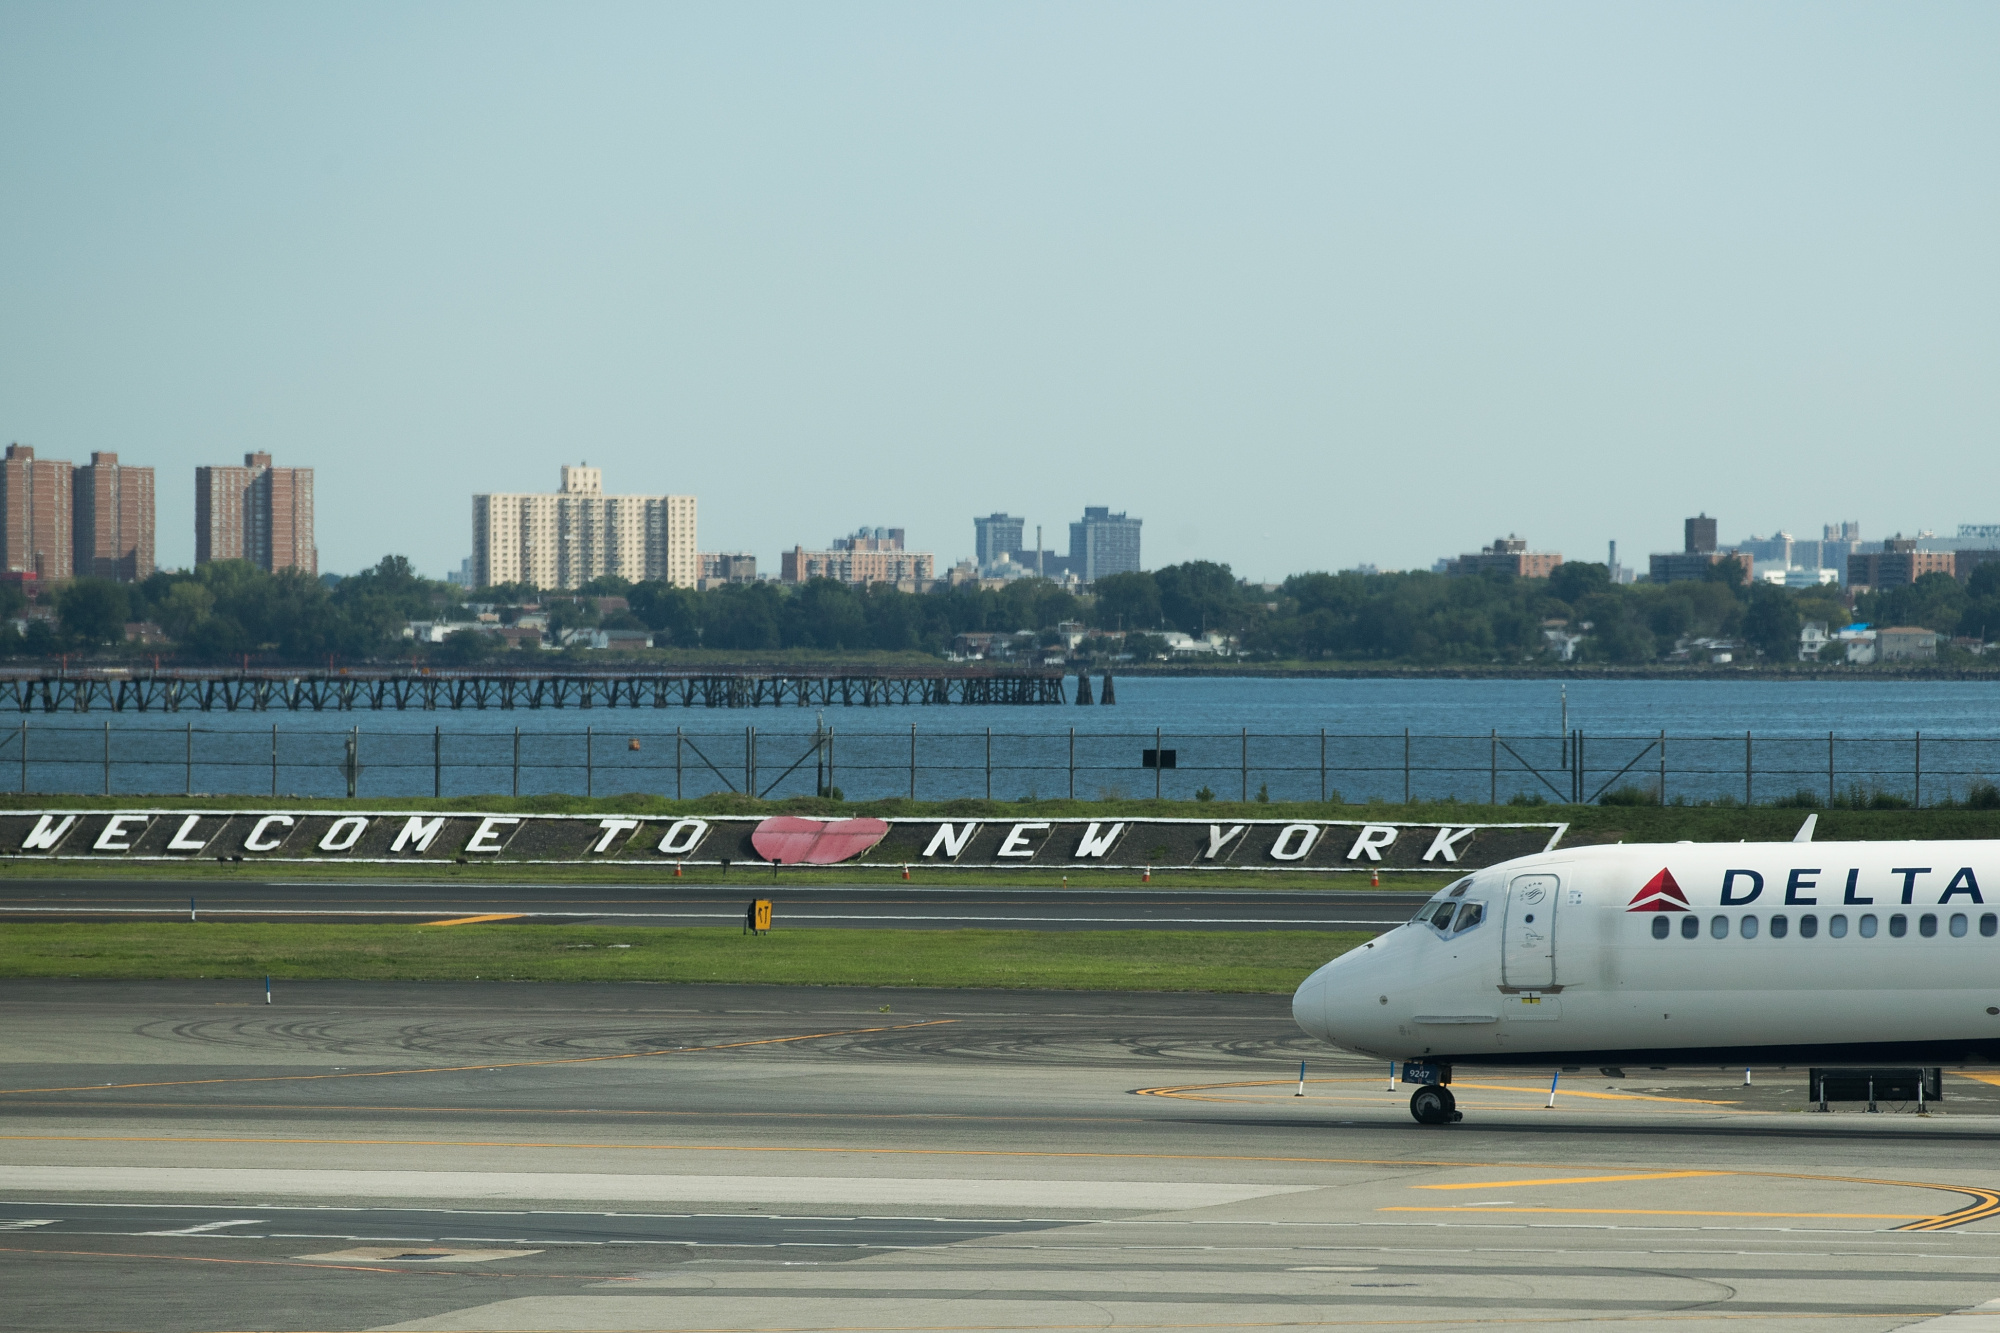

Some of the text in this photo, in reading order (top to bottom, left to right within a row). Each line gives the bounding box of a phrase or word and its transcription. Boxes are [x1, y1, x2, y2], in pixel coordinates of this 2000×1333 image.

[22, 814, 1476, 862] WELCOME TO NEW YORK
[1720, 867, 1985, 906] DELTA
[1409, 1069, 1430, 1079] 9247
